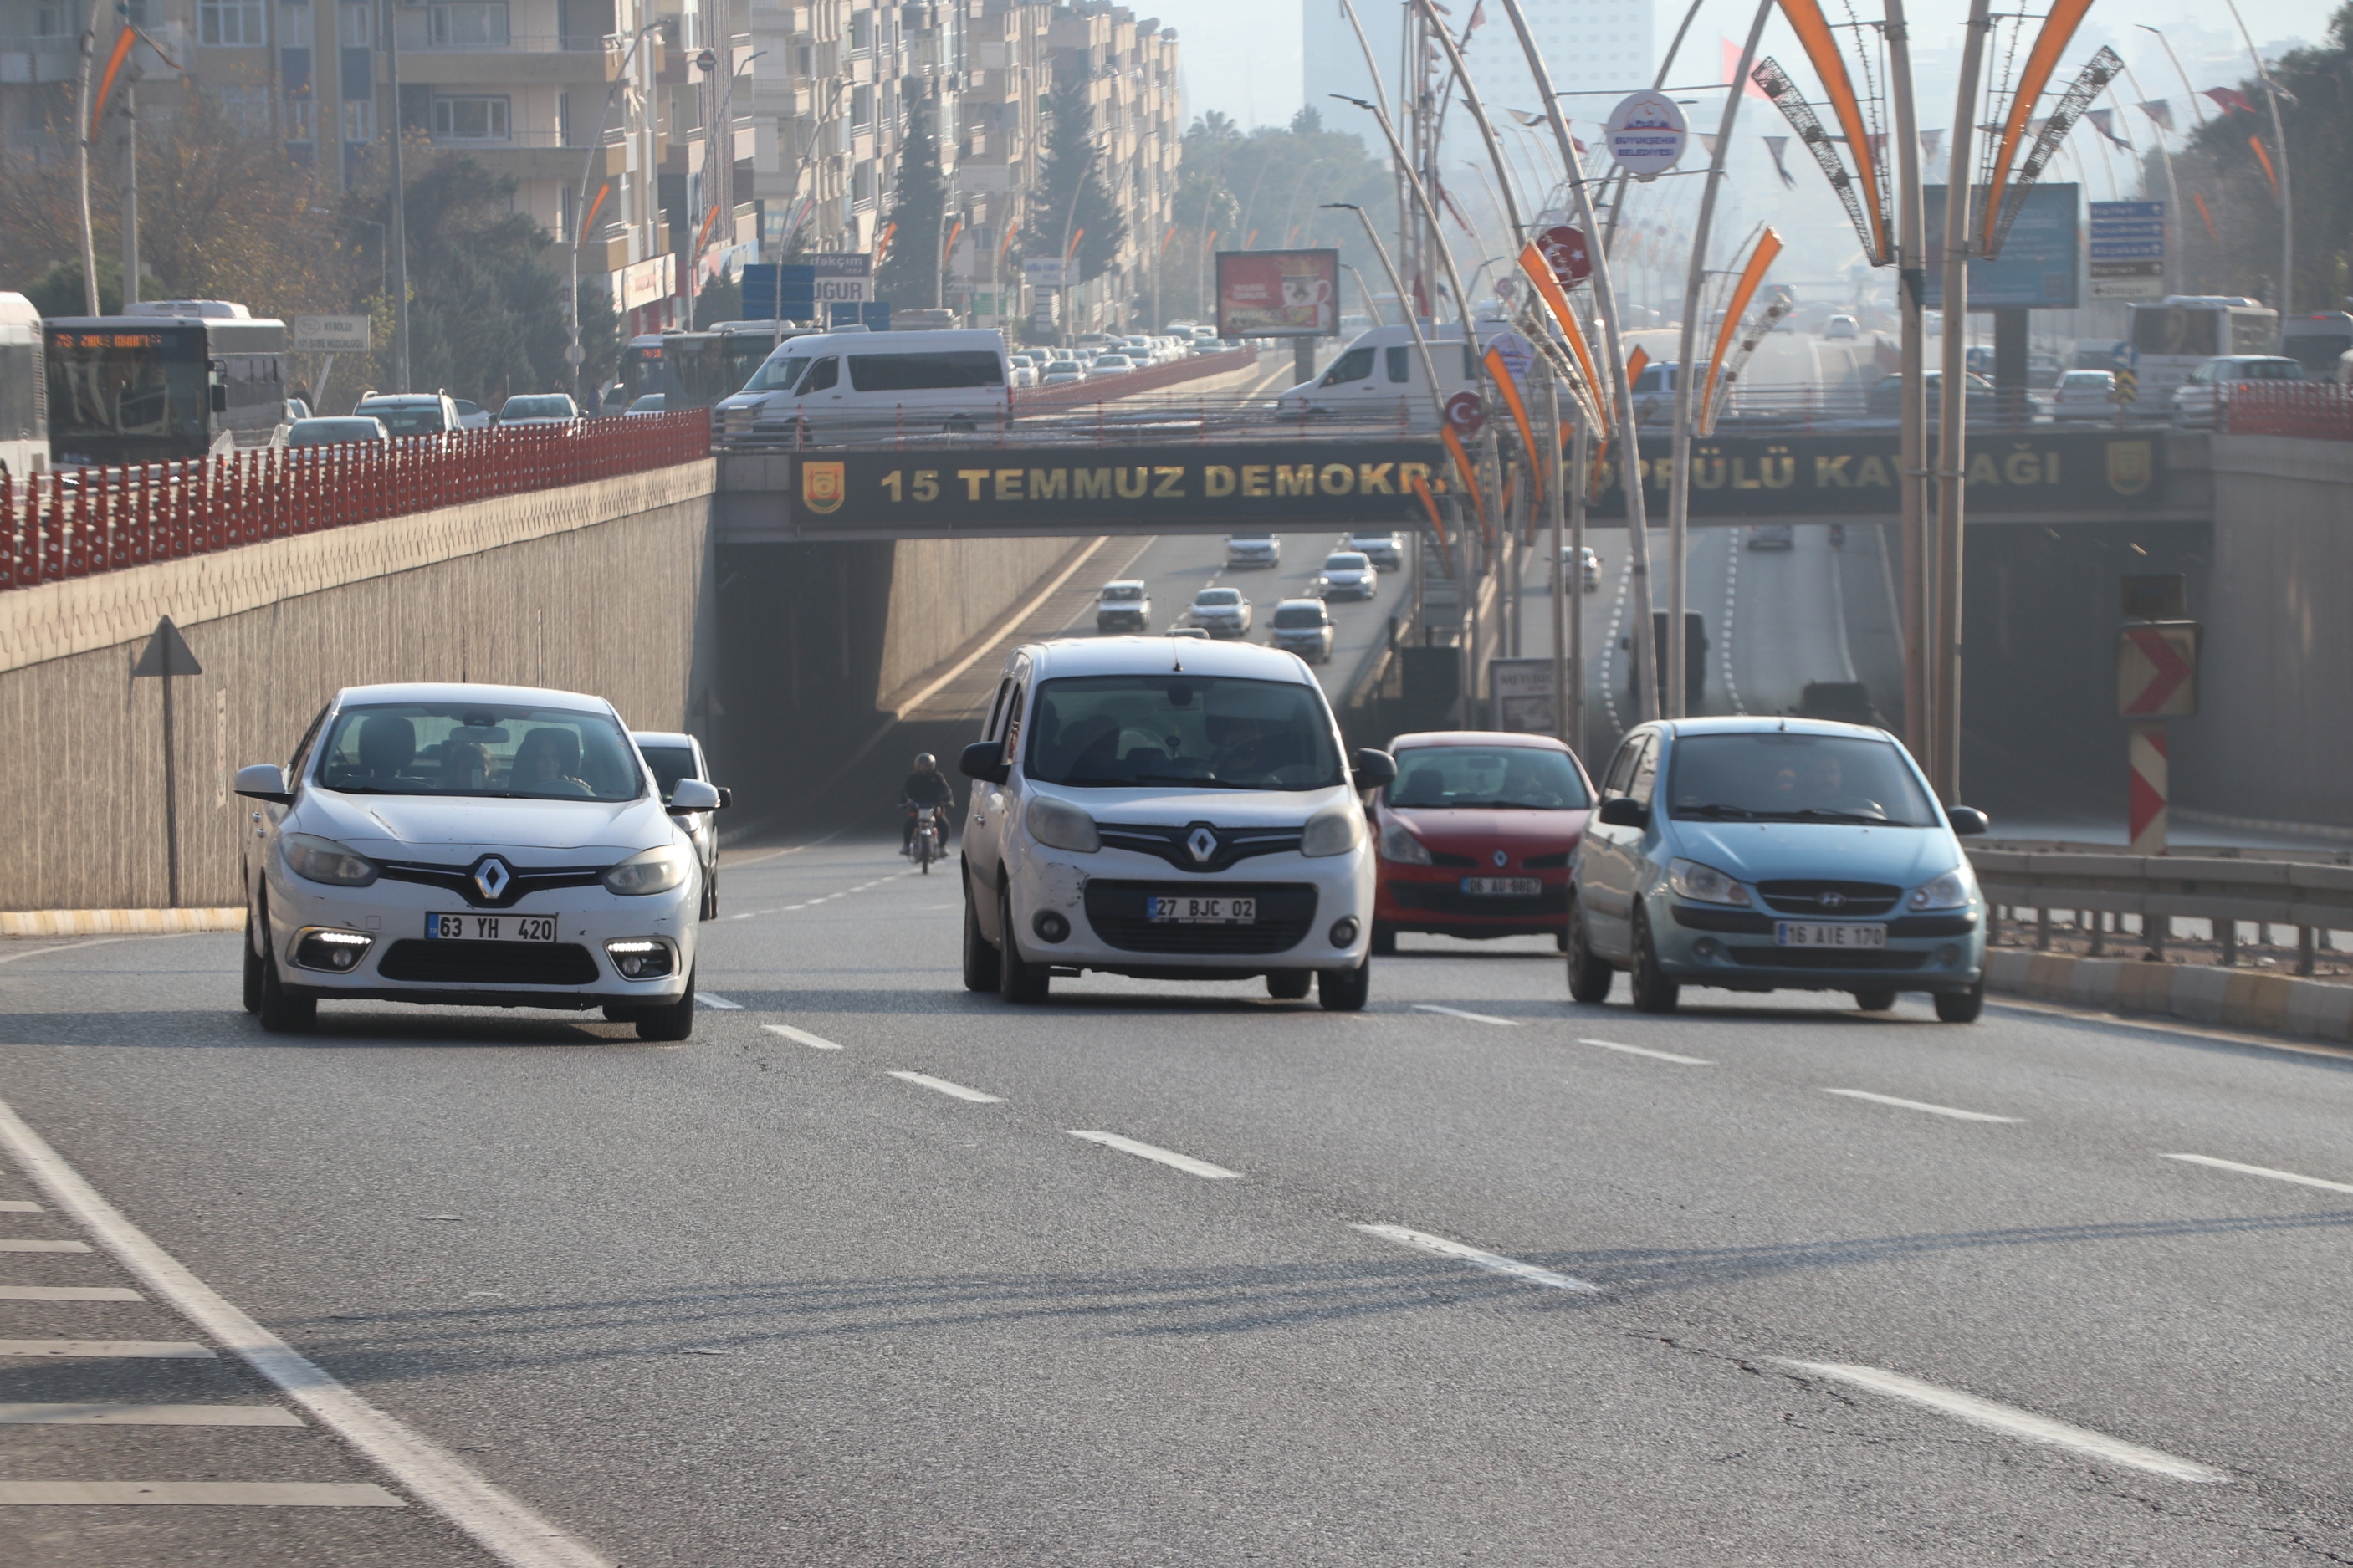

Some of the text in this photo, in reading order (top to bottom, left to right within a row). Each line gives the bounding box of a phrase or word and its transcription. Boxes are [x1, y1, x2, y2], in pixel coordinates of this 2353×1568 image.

[881, 469, 940, 502] 15
[958, 466, 1186, 500] TEMMUZ
[1157, 899, 1253, 917] 27 BJC 02
[440, 917, 463, 937] 63
[477, 917, 499, 938] YH
[518, 919, 552, 941] 420
[1789, 926, 1807, 944] 16
[1854, 928, 1882, 946] 170
